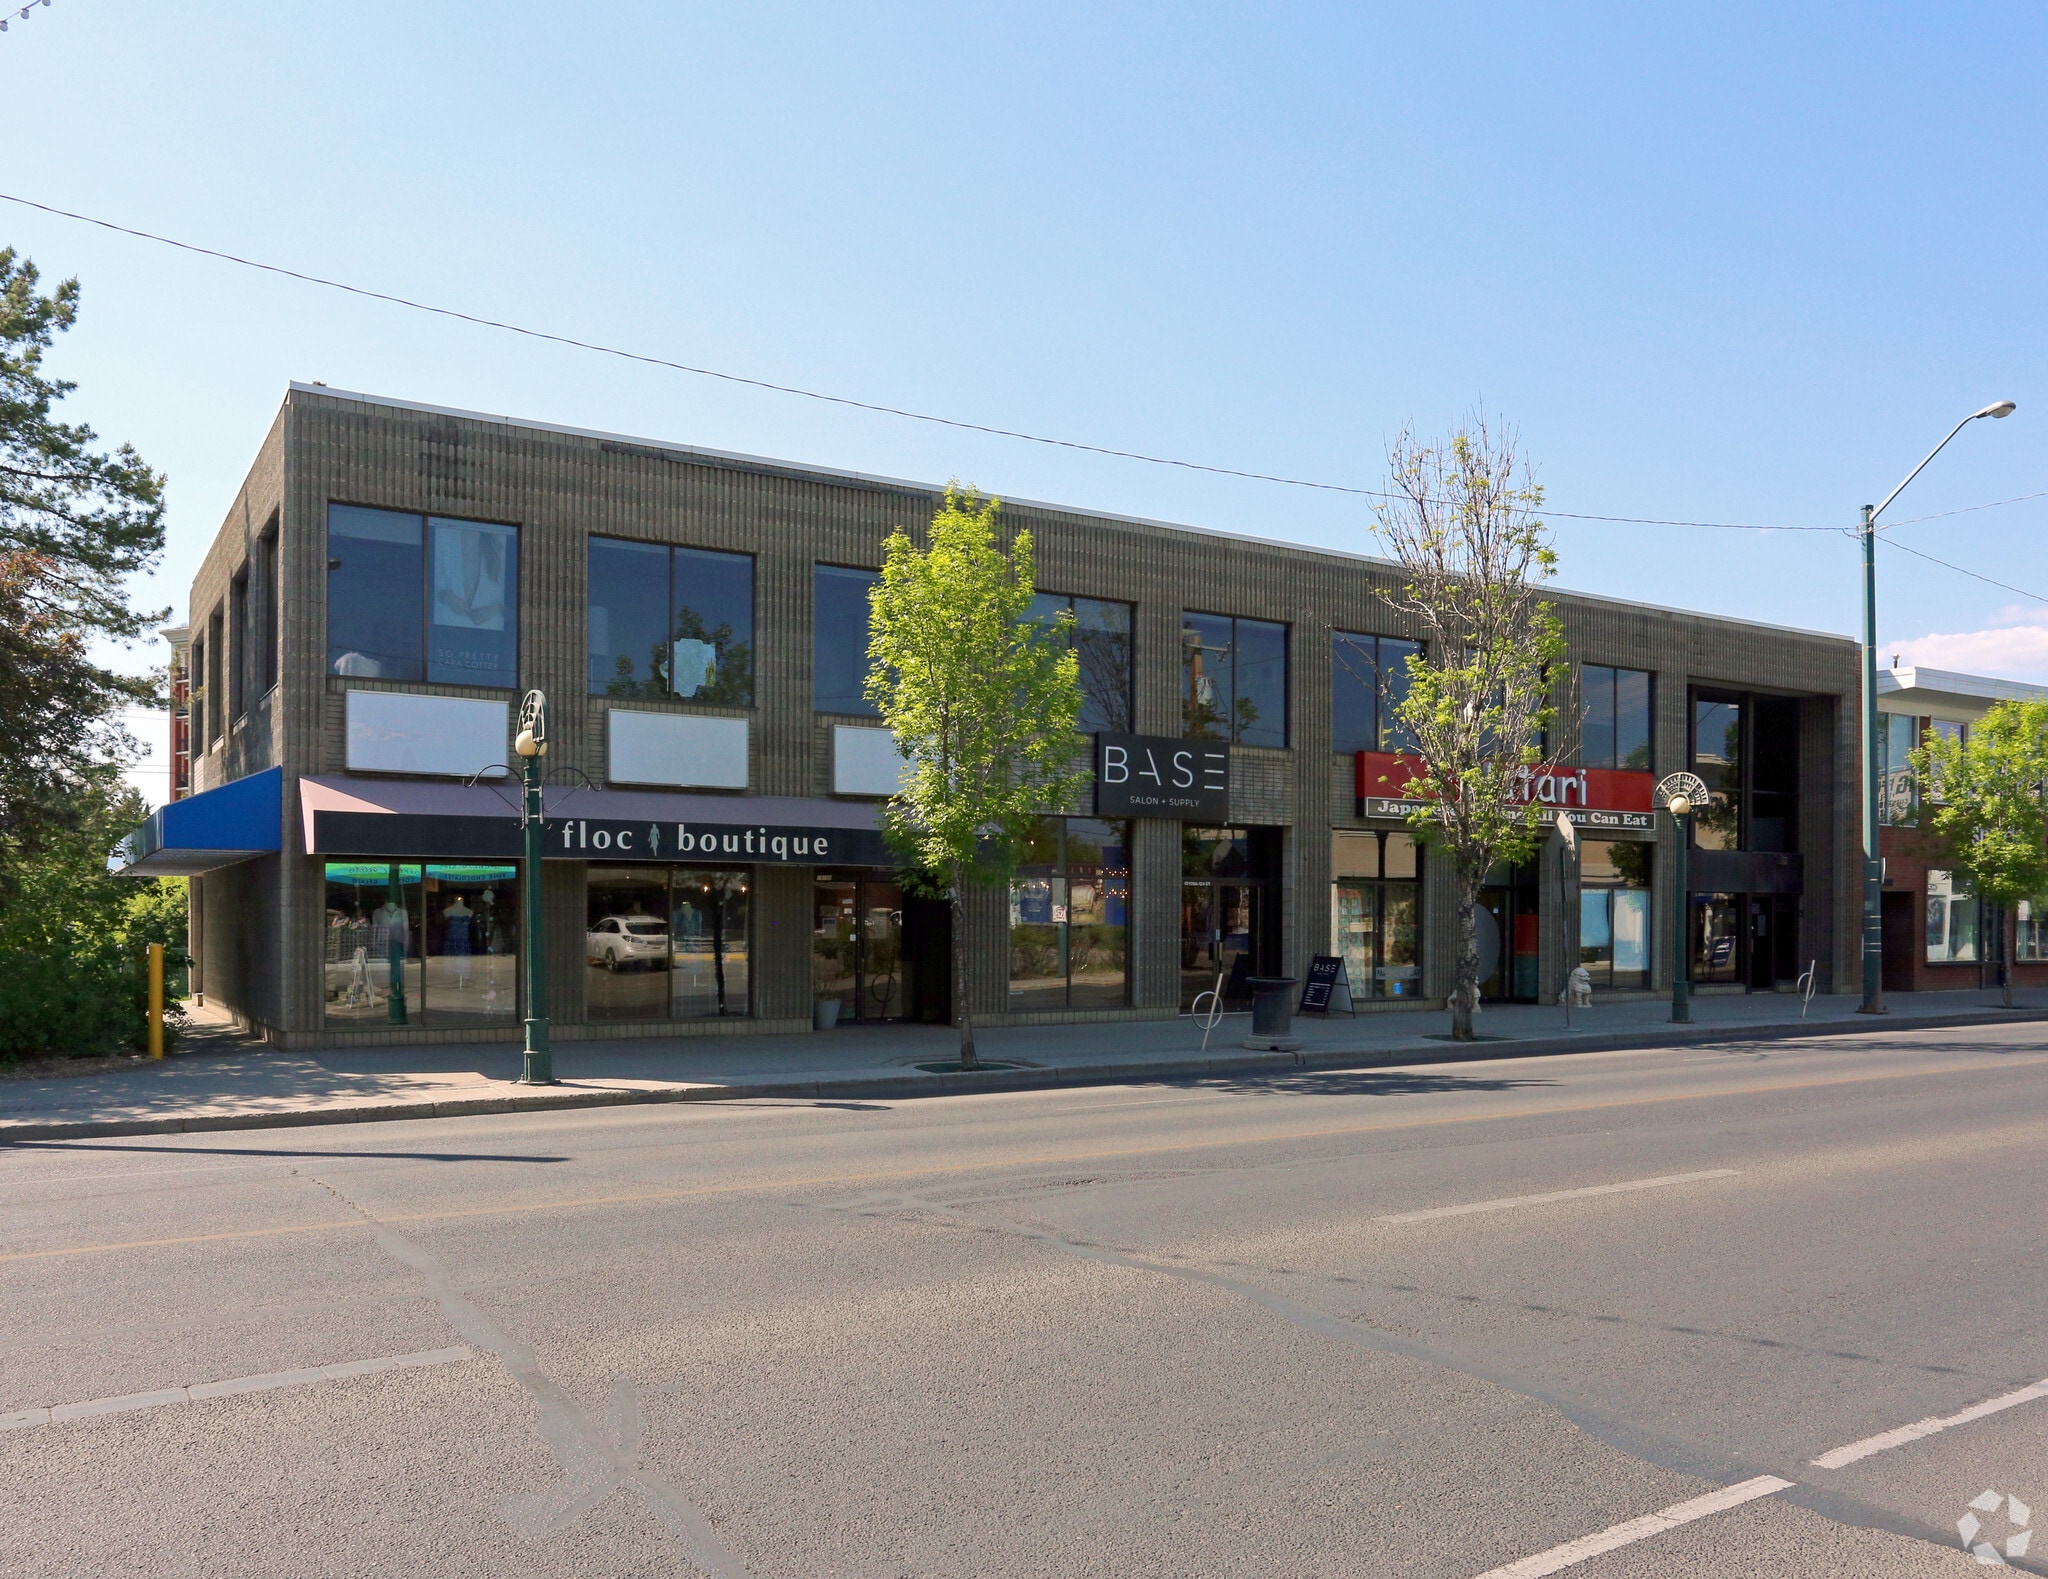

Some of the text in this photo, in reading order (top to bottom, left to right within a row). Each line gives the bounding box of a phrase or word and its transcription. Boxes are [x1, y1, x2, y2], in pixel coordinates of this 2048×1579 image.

[438, 648, 499, 662] SO PRETTY
[1104, 745, 1225, 790] BASE
[1129, 795, 1159, 805] SALON
[1168, 797, 1200, 807] SUPPLY
[1590, 812, 1619, 825] Can
[1622, 813, 1648, 826] Eat
[562, 820, 829, 860] floc boutique
[1313, 963, 1337, 973] BASE
